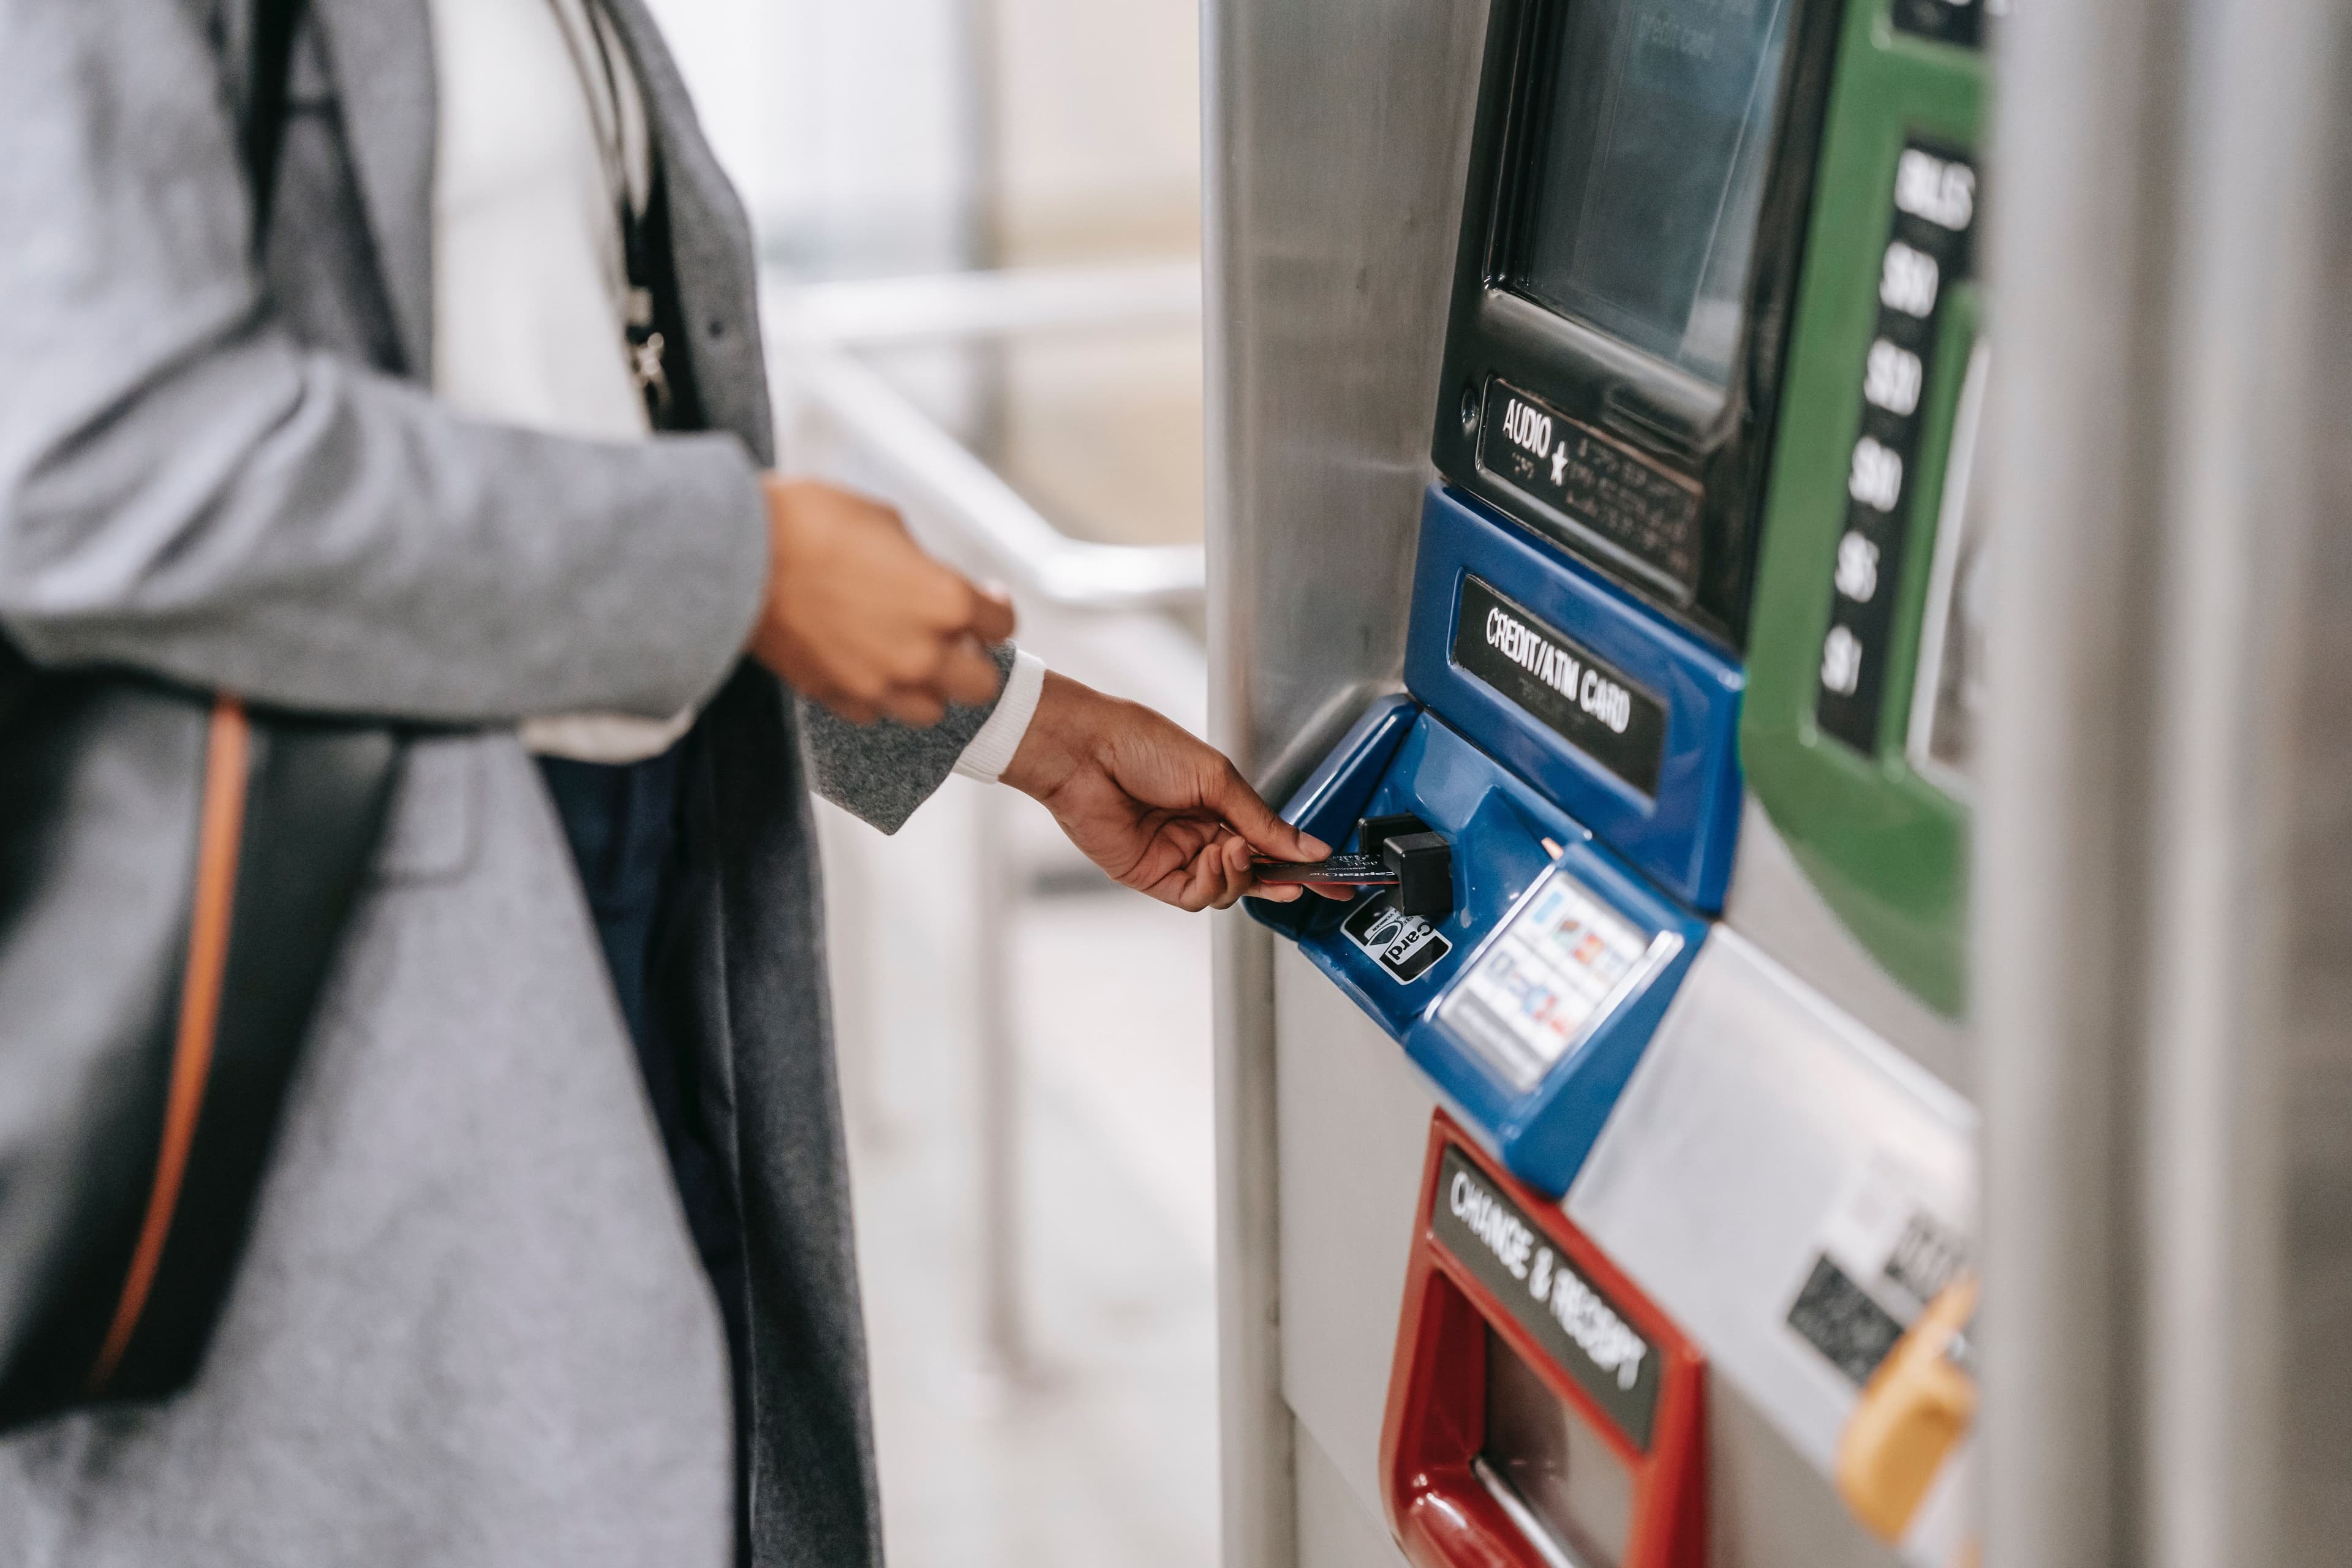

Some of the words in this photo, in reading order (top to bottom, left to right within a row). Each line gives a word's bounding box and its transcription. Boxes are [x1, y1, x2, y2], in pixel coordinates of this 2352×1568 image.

[1502, 398, 1552, 458] AUDIO
[1487, 607, 1580, 701] CREDIT/ATM
[1580, 669, 1631, 734] CARD
[1387, 921, 1434, 961] Card
